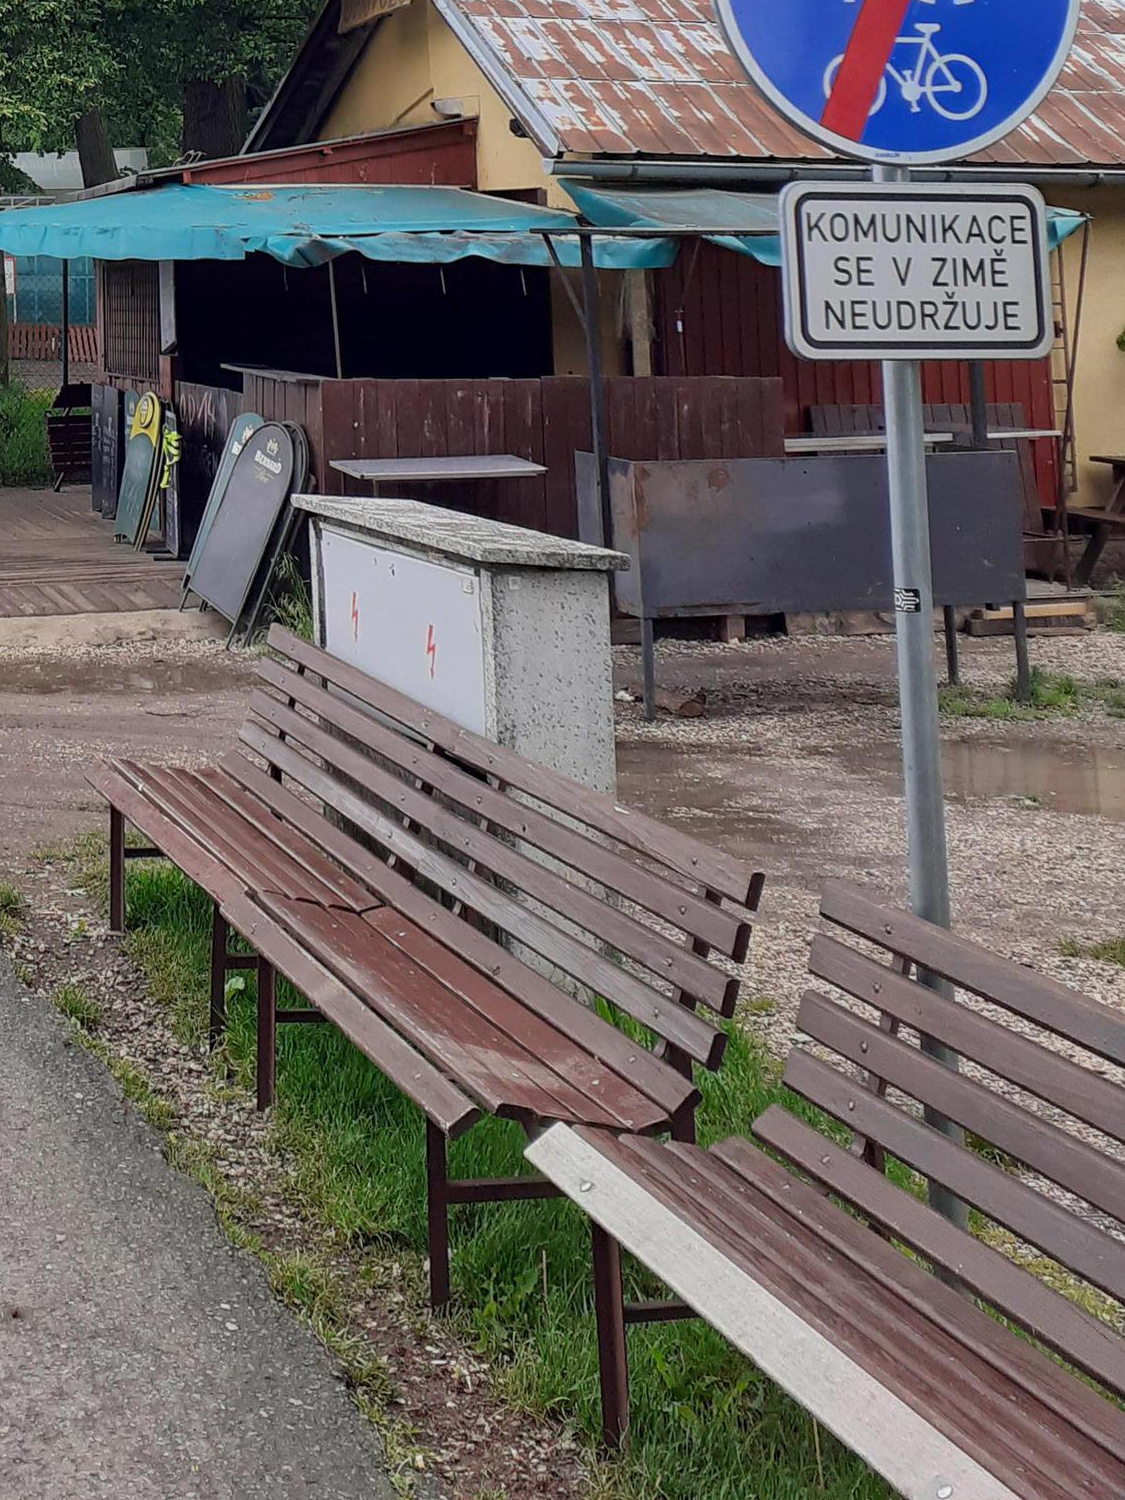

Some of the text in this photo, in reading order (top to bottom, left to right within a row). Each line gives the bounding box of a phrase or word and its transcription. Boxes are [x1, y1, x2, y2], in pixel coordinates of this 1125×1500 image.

[806, 211, 1028, 245] KOMUNIKACE
[833, 248, 1009, 288] SE V ZIMĚ
[824, 291, 1021, 331] NEUDRŽUJE
